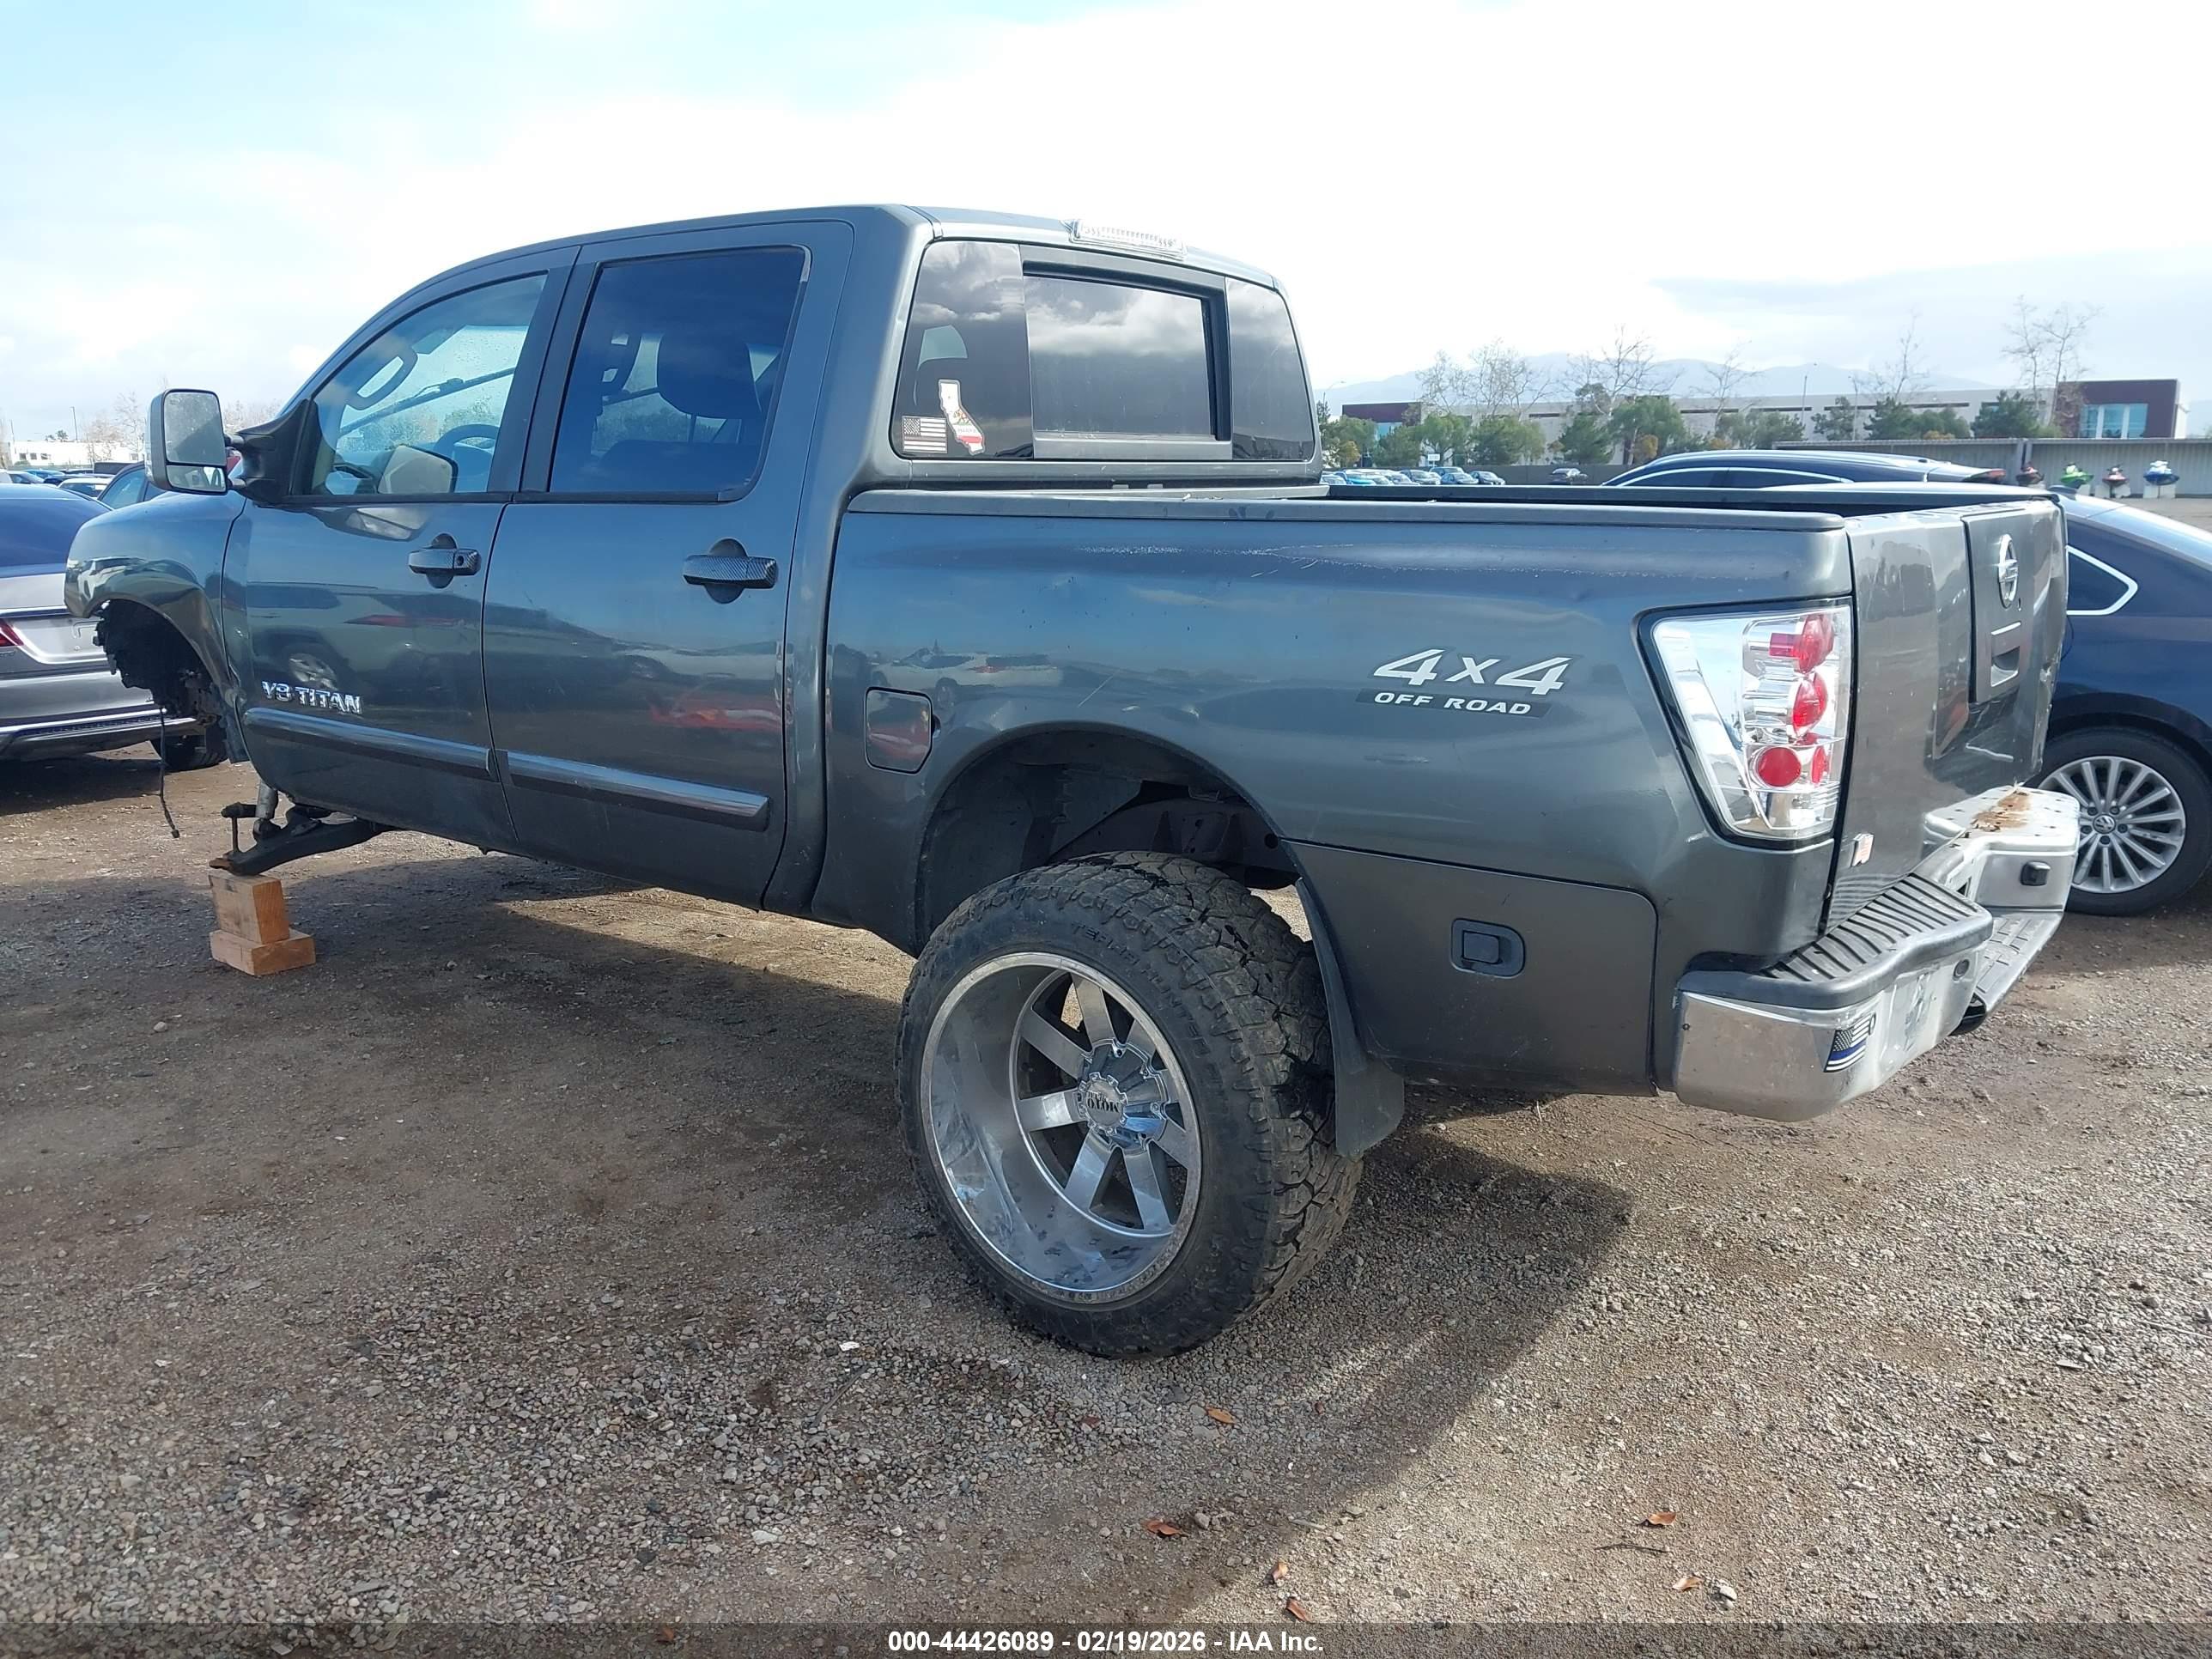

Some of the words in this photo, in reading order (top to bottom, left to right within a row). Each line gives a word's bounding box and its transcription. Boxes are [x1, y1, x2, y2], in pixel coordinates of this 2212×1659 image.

[261, 681, 292, 702] V8
[295, 686, 362, 714] TITAN
[1374, 692, 1434, 706] OFF
[1443, 697, 1531, 714] ROAD
[1087, 1097, 1120, 1113] MOTO
